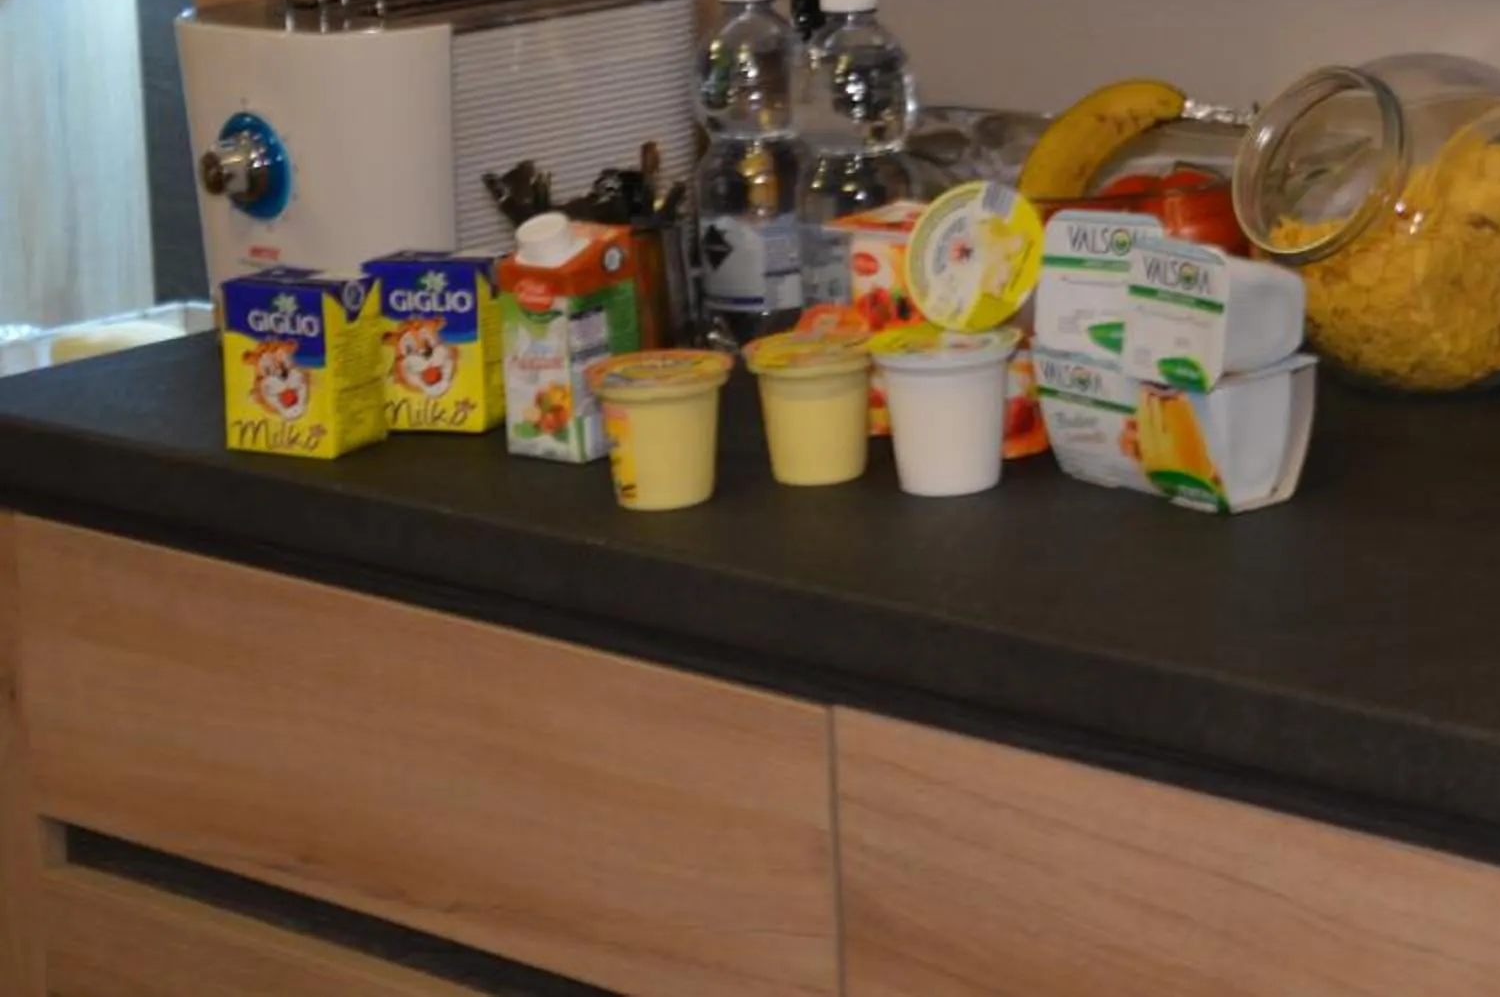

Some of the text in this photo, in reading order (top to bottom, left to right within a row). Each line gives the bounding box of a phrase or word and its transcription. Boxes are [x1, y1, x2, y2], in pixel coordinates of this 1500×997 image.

[1143, 255, 1213, 294] VALSOIA
[389, 289, 473, 313] GIGLIO
[247, 309, 320, 338] GIGLIO
